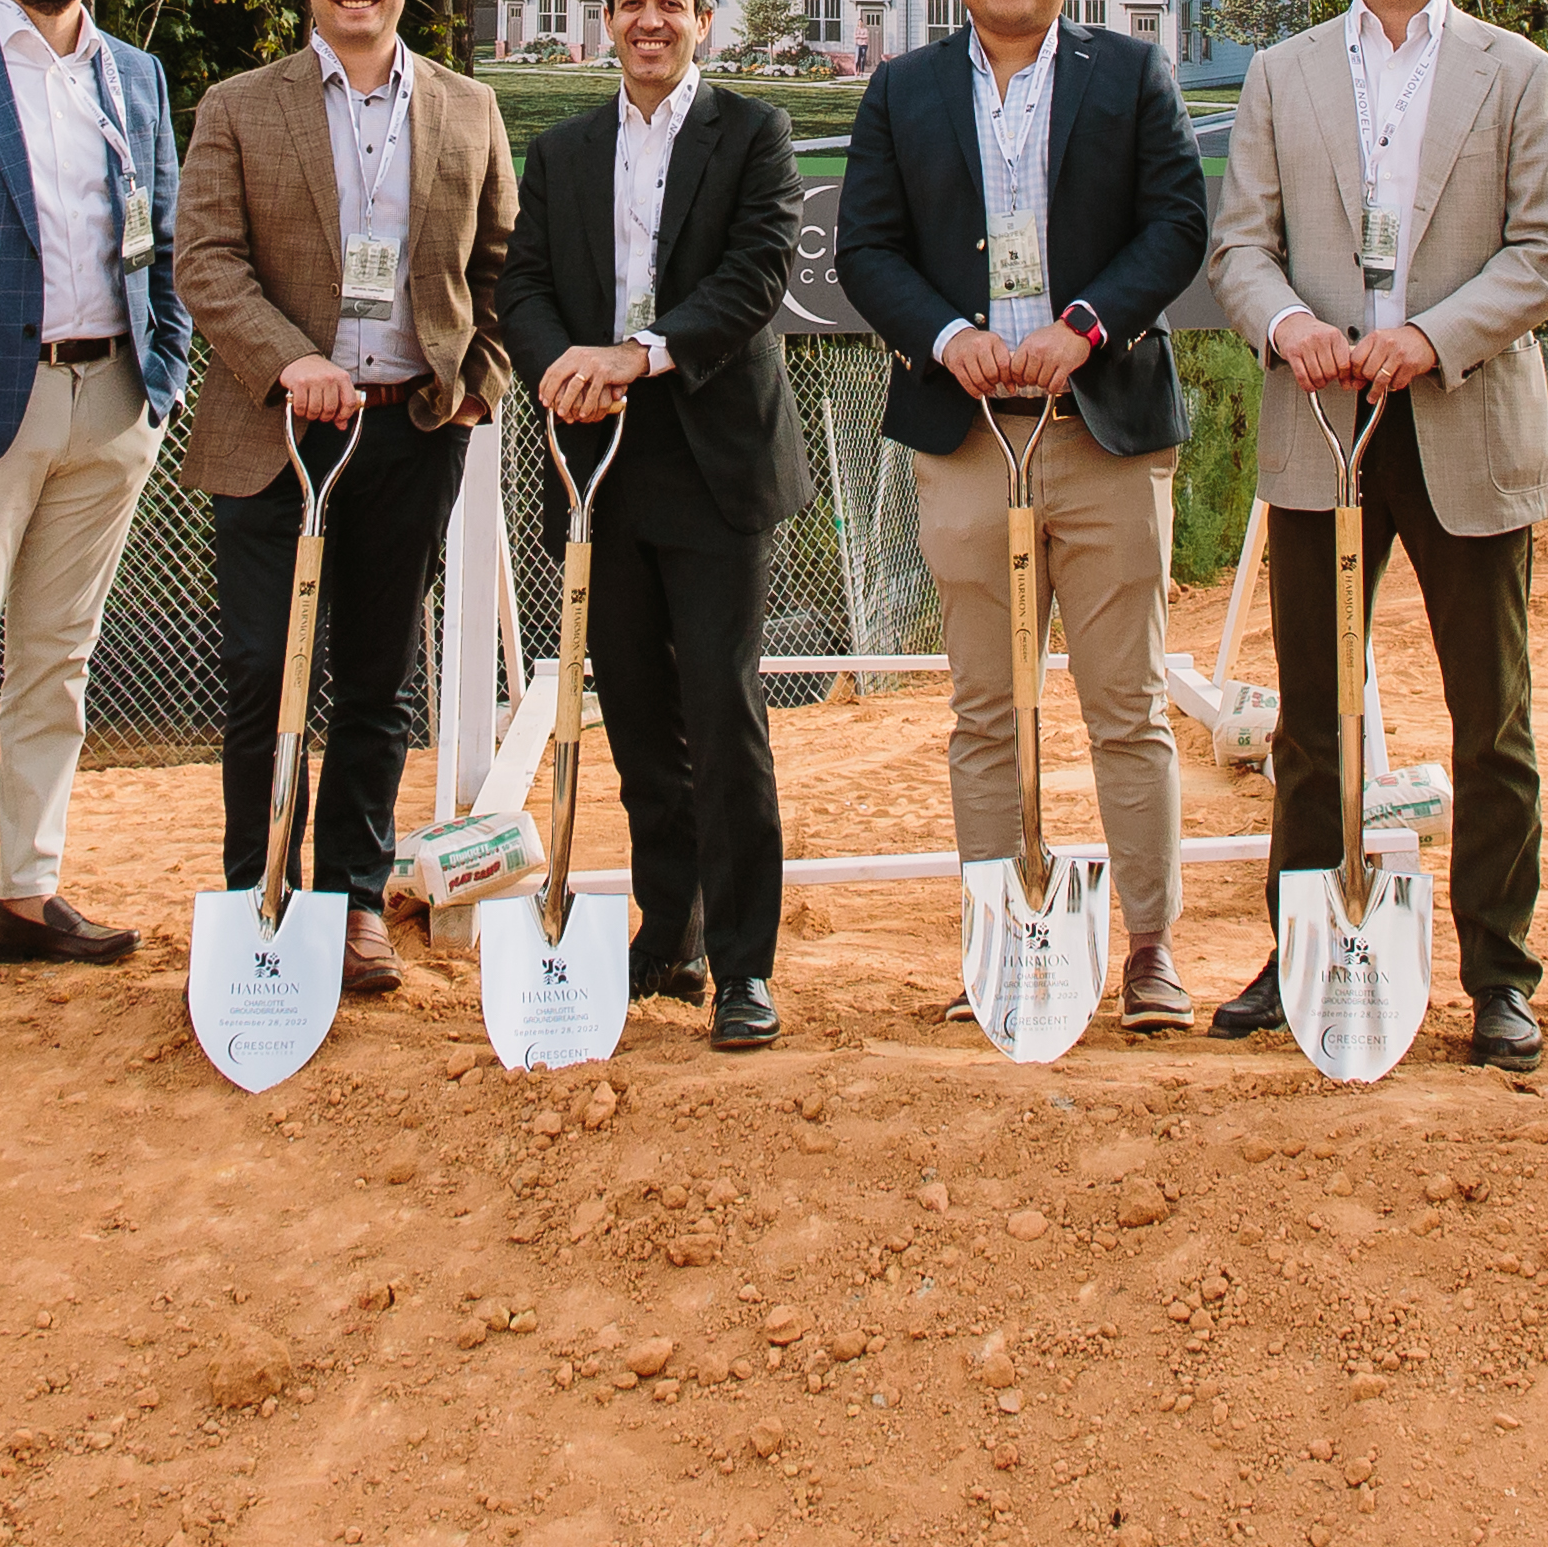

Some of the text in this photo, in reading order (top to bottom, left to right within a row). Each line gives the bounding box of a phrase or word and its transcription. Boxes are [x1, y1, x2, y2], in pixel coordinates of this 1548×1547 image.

[1403, 62, 1430, 99] NOVEL
[1357, 91, 1371, 135] NOVEL
[1018, 574, 1026, 618] HARMON
[1345, 575, 1354, 621] HARMON
[299, 599, 310, 643] HARMON
[573, 608, 582, 653] HARMON
[1003, 954, 1070, 968] HARMON
[1321, 970, 1390, 984] HARMON
[231, 982, 300, 995] HARMON
[1003, 979, 1069, 989] GROUNDBREAKING
[522, 987, 589, 1004] HARMON
[1057, 991, 1079, 1000] 2022
[1334, 988, 1375, 997] CHARLOTTE
[244, 999, 285, 1007] CHARLOTTE
[1321, 997, 1389, 1006] GROUNDBREAKING
[536, 1006, 575, 1015] CHARLOTTE
[1310, 1009, 1357, 1018] September
[1377, 1011, 1400, 1019] 2022
[219, 1018, 265, 1027] September
[285, 1018, 308, 1026] 2022
[523, 1013, 589, 1024] GROUNDBREAKING
[1010, 1015, 1068, 1026] CRESCENT
[514, 1028, 558, 1037] September
[577, 1024, 599, 1033] 2022
[234, 1040, 295, 1050] CRESCENT
[1327, 1034, 1388, 1045] CRESCENT
[531, 1048, 589, 1060] CRESCENT
